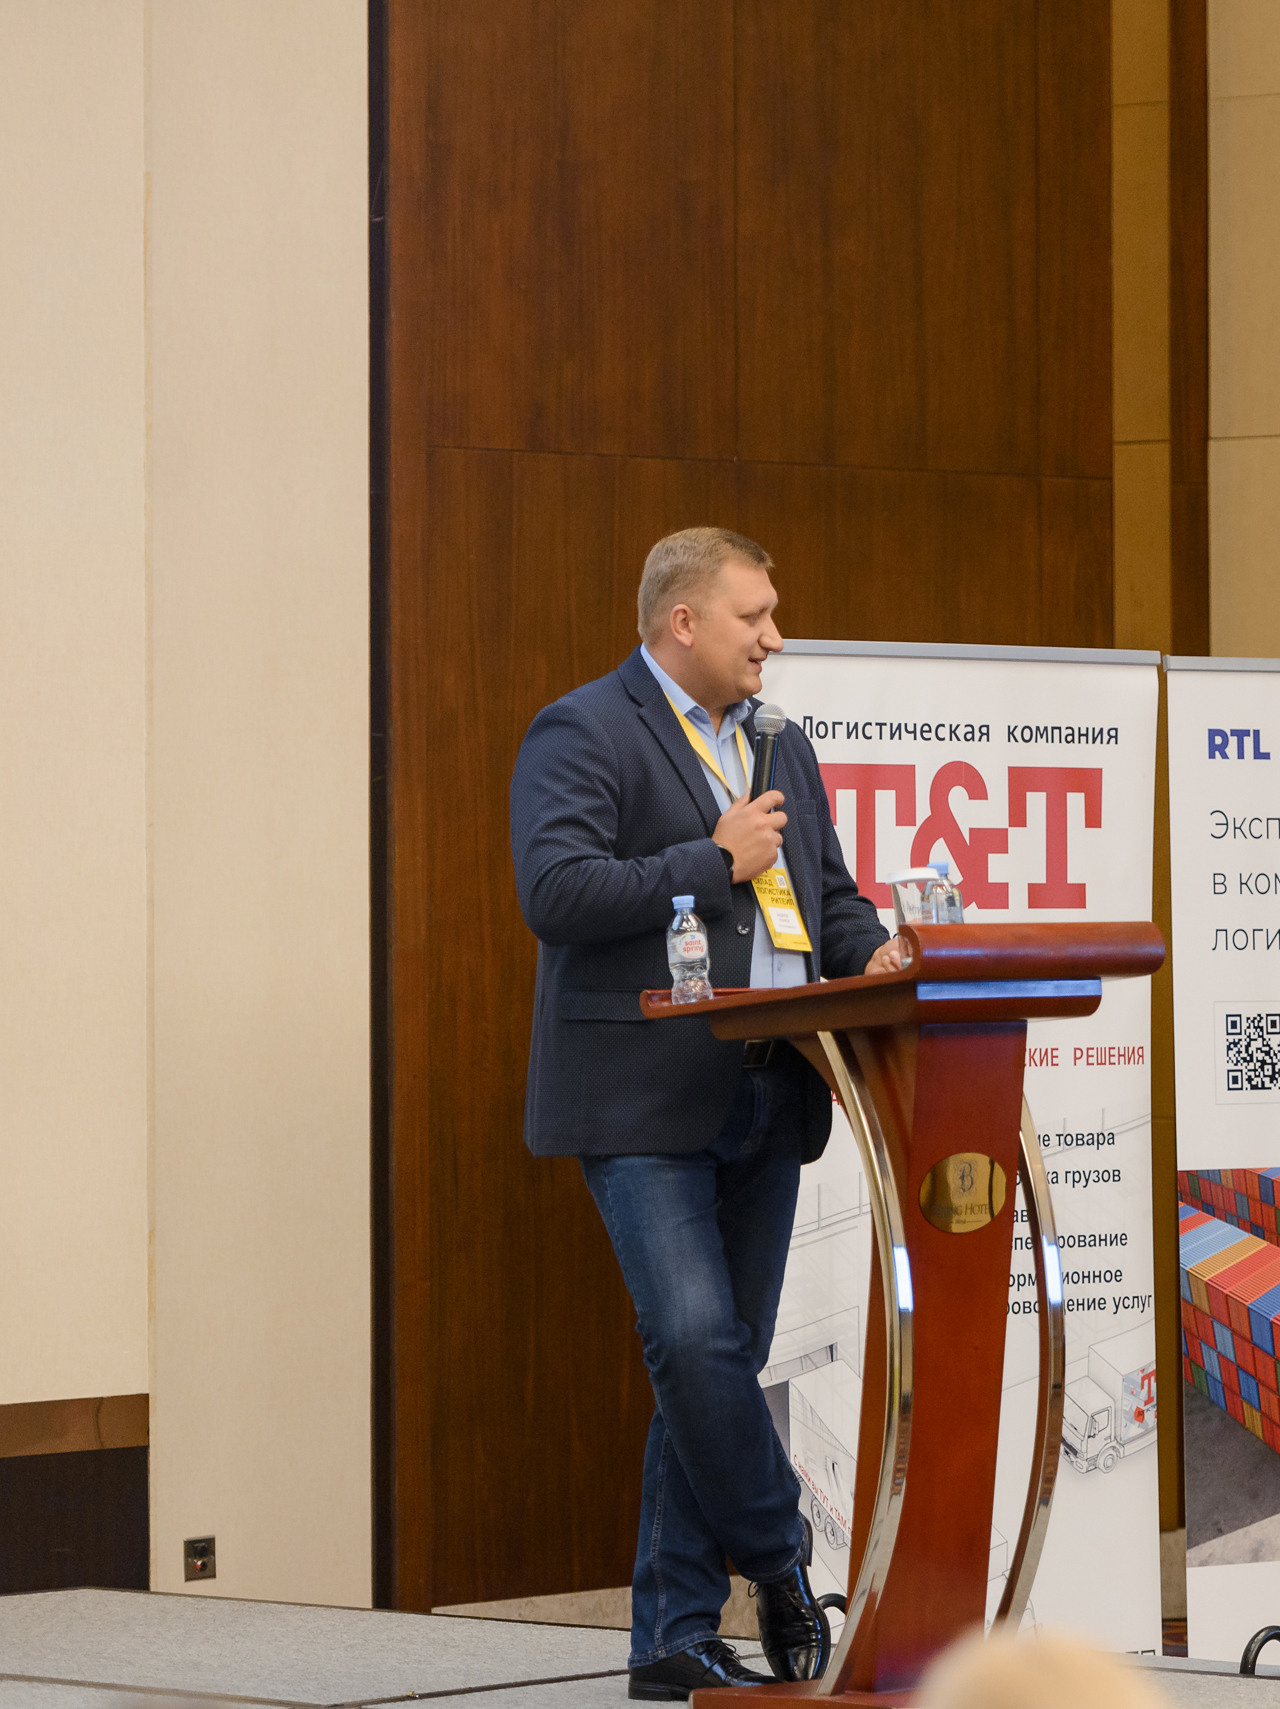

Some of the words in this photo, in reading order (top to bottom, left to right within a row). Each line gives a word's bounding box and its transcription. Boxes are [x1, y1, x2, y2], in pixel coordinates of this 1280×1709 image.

[801, 715, 990, 743] Логистическая
[1007, 724, 1119, 745] компания
[1207, 728, 1271, 760] RTL
[819, 760, 1103, 910] T&T
[1212, 872, 1228, 895] в
[1025, 1047, 1059, 1067] КИЕ
[1073, 1046, 1145, 1066] РЕШЕНИЯ
[1056, 1132, 1115, 1150] товара
[1064, 1169, 1121, 1188] грузов
[964, 1203, 993, 1217] HOTE
[1112, 1294, 1152, 1314] услуг
